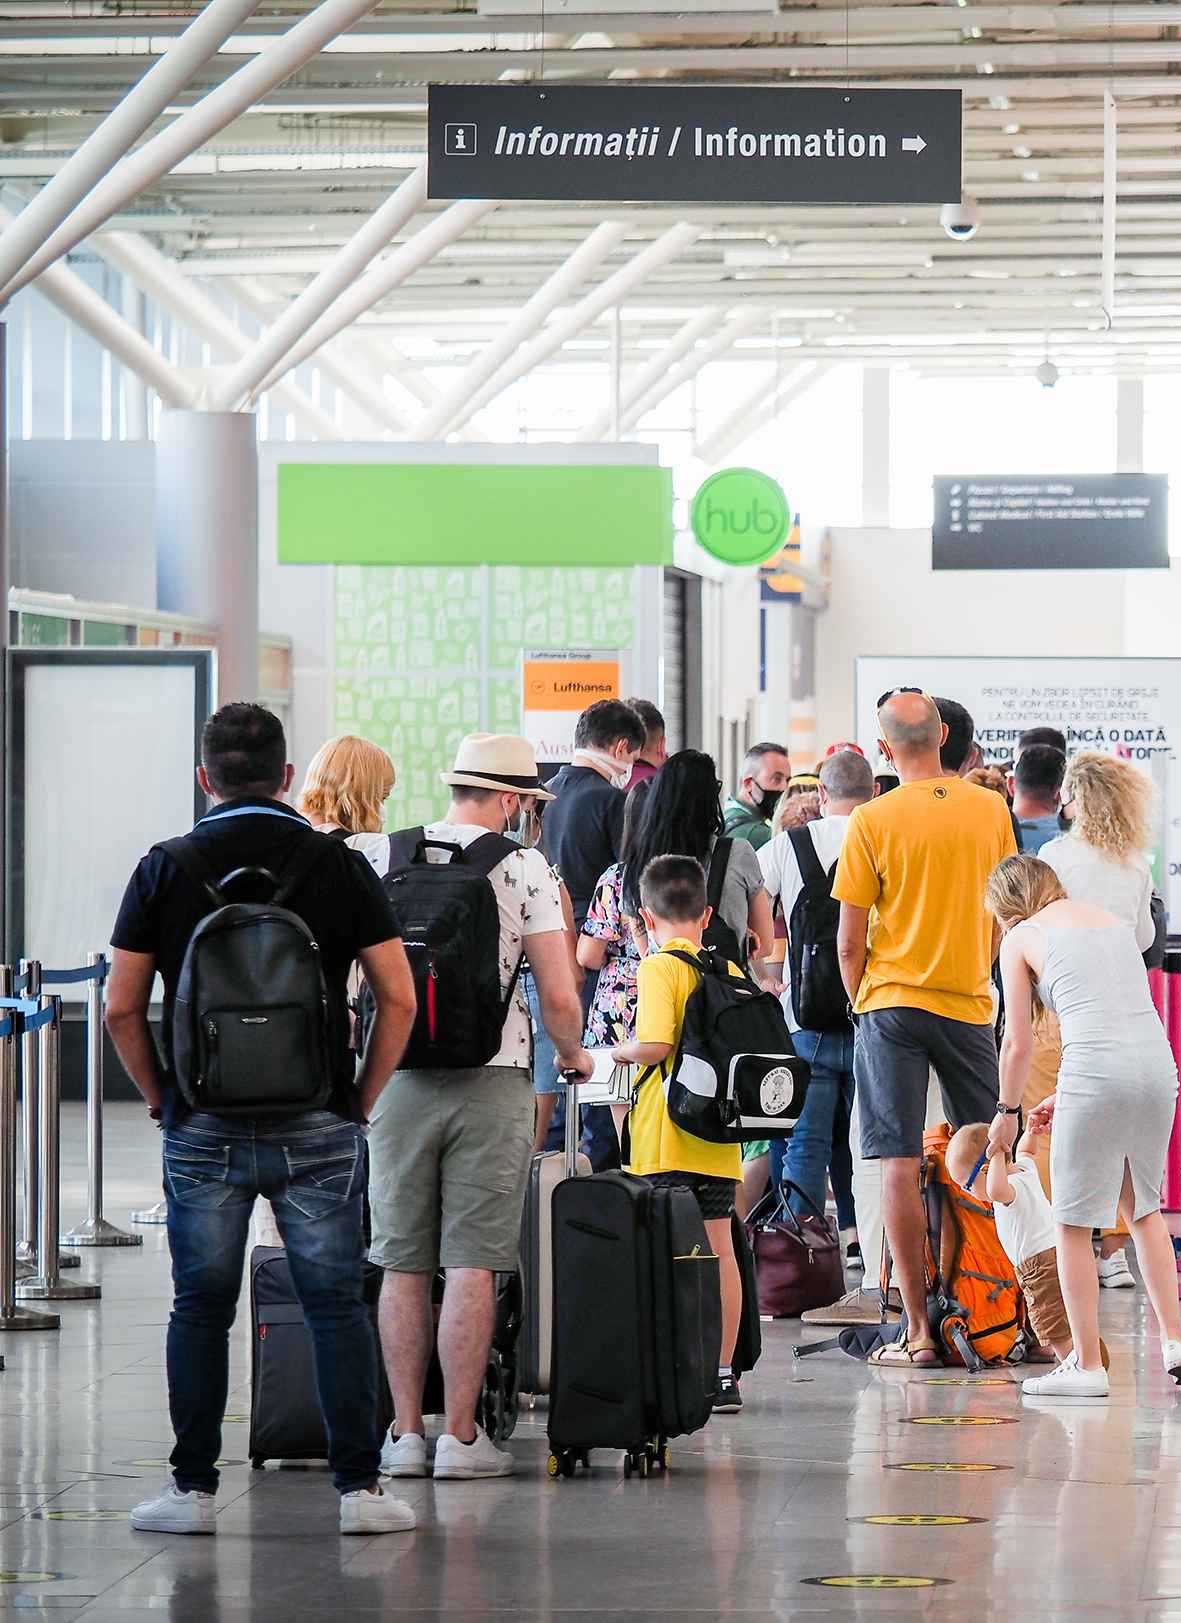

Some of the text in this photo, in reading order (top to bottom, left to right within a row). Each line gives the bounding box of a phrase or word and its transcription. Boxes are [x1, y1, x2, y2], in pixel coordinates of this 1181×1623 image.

[694, 127, 887, 158] Information
[705, 497, 778, 535] hub
[553, 681, 613, 693] Lufthansa
[1123, 726, 1167, 742] DATĂ
